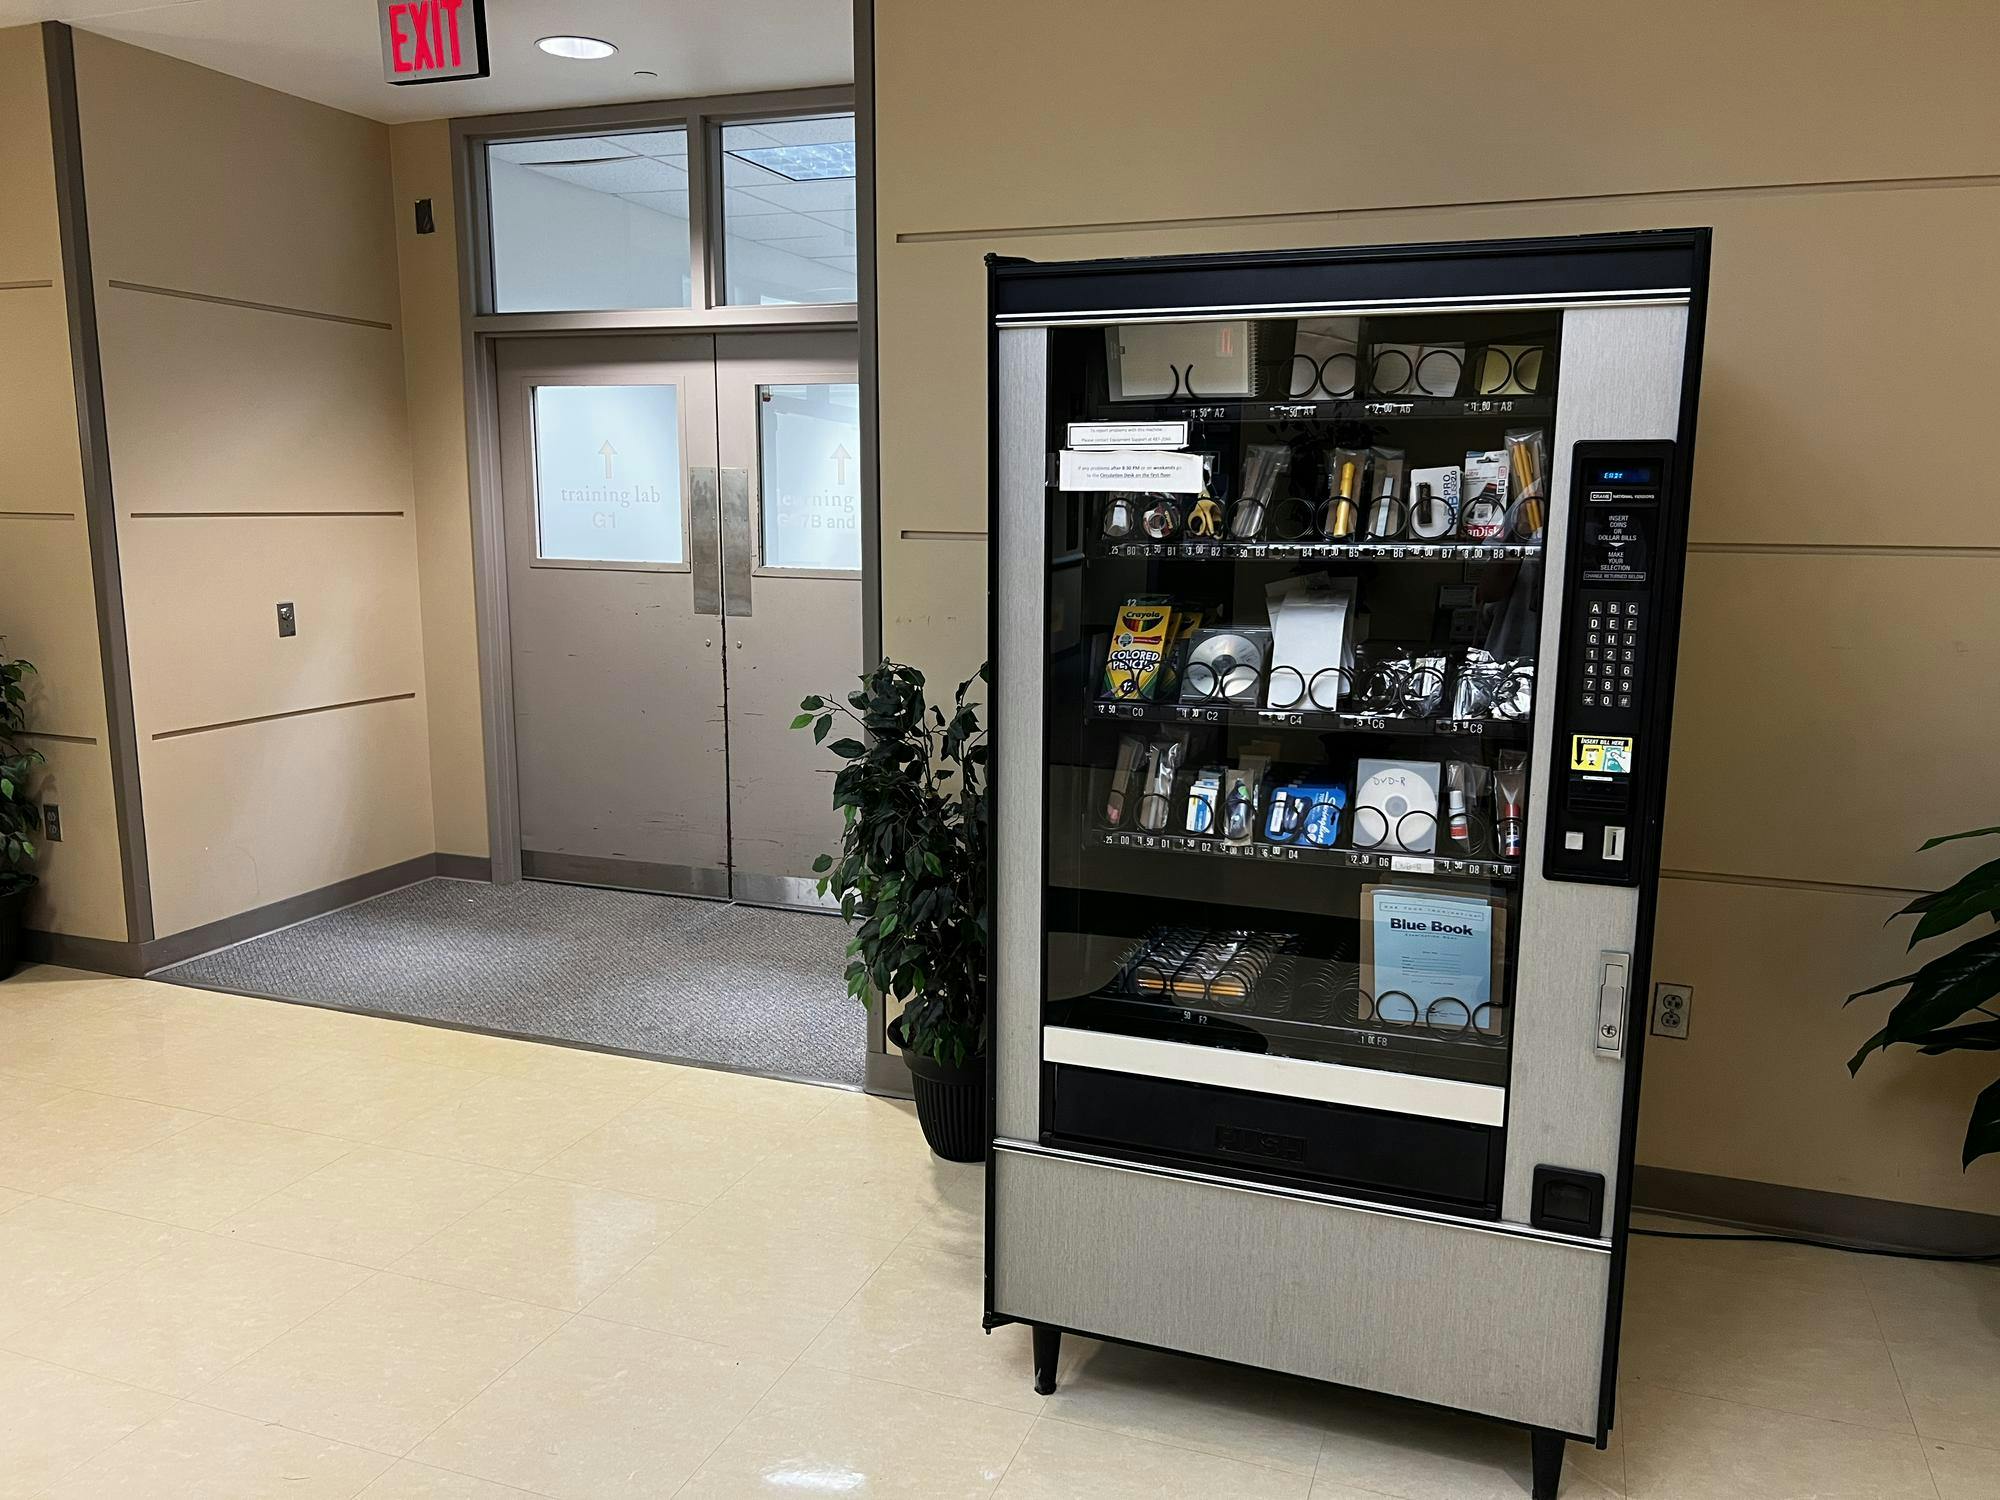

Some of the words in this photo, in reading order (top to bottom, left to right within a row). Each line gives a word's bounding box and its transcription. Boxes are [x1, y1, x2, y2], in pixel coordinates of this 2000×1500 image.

[388, 0, 463, 73] EXIT
[1500, 401, 1512, 412] A8
[1214, 408, 1225, 418] A2
[1442, 474, 1451, 495] PRO
[560, 484, 631, 509] training
[635, 485, 661, 503] lab
[776, 488, 855, 513] lerning
[592, 511, 616, 529] G1
[777, 512, 822, 529] G7B
[826, 514, 856, 529] and
[1210, 547, 1221, 557] B2
[1255, 547, 1265, 557] B3
[1302, 548, 1312, 557] B4
[1348, 548, 1359, 558] B5
[1393, 548, 1404, 558] B6
[1441, 548, 1453, 559] B7
[1493, 548, 1504, 559] B8
[1592, 604, 1599, 613] A
[1610, 604, 1617, 613] B
[1628, 605, 1635, 613] C
[1126, 611, 1160, 619] Crayola
[1591, 619, 1598, 628] D
[1609, 620, 1616, 629] E
[1627, 620, 1634, 629] F
[1589, 635, 1596, 643] G
[1608, 635, 1615, 644] H
[1626, 636, 1632, 644] J
[1111, 650, 1159, 662] COLORED
[1589, 650, 1594, 658] 1
[1607, 651, 1613, 659] 2
[1625, 651, 1631, 659] 3
[1112, 659, 1155, 672] PENCIS
[1587, 665, 1593, 673] 4
[1606, 665, 1612, 674] 5
[1623, 666, 1630, 675] 6
[1587, 680, 1593, 689] 7
[1604, 681, 1611, 690] 8
[1622, 682, 1629, 691] 9
[1603, 696, 1609, 705] 0
[1206, 711, 1219, 721] C2
[1290, 714, 1303, 725] C4
[1372, 719, 1385, 729] C6
[1469, 723, 1483, 734] C8
[1580, 737, 1599, 745] INSERT
[1373, 776, 1406, 786] DVD-R
[1390, 917, 1427, 932] Blue
[1430, 920, 1473, 937] Book
[1198, 1015, 1208, 1025] F2
[1377, 1036, 1388, 1047] F8
